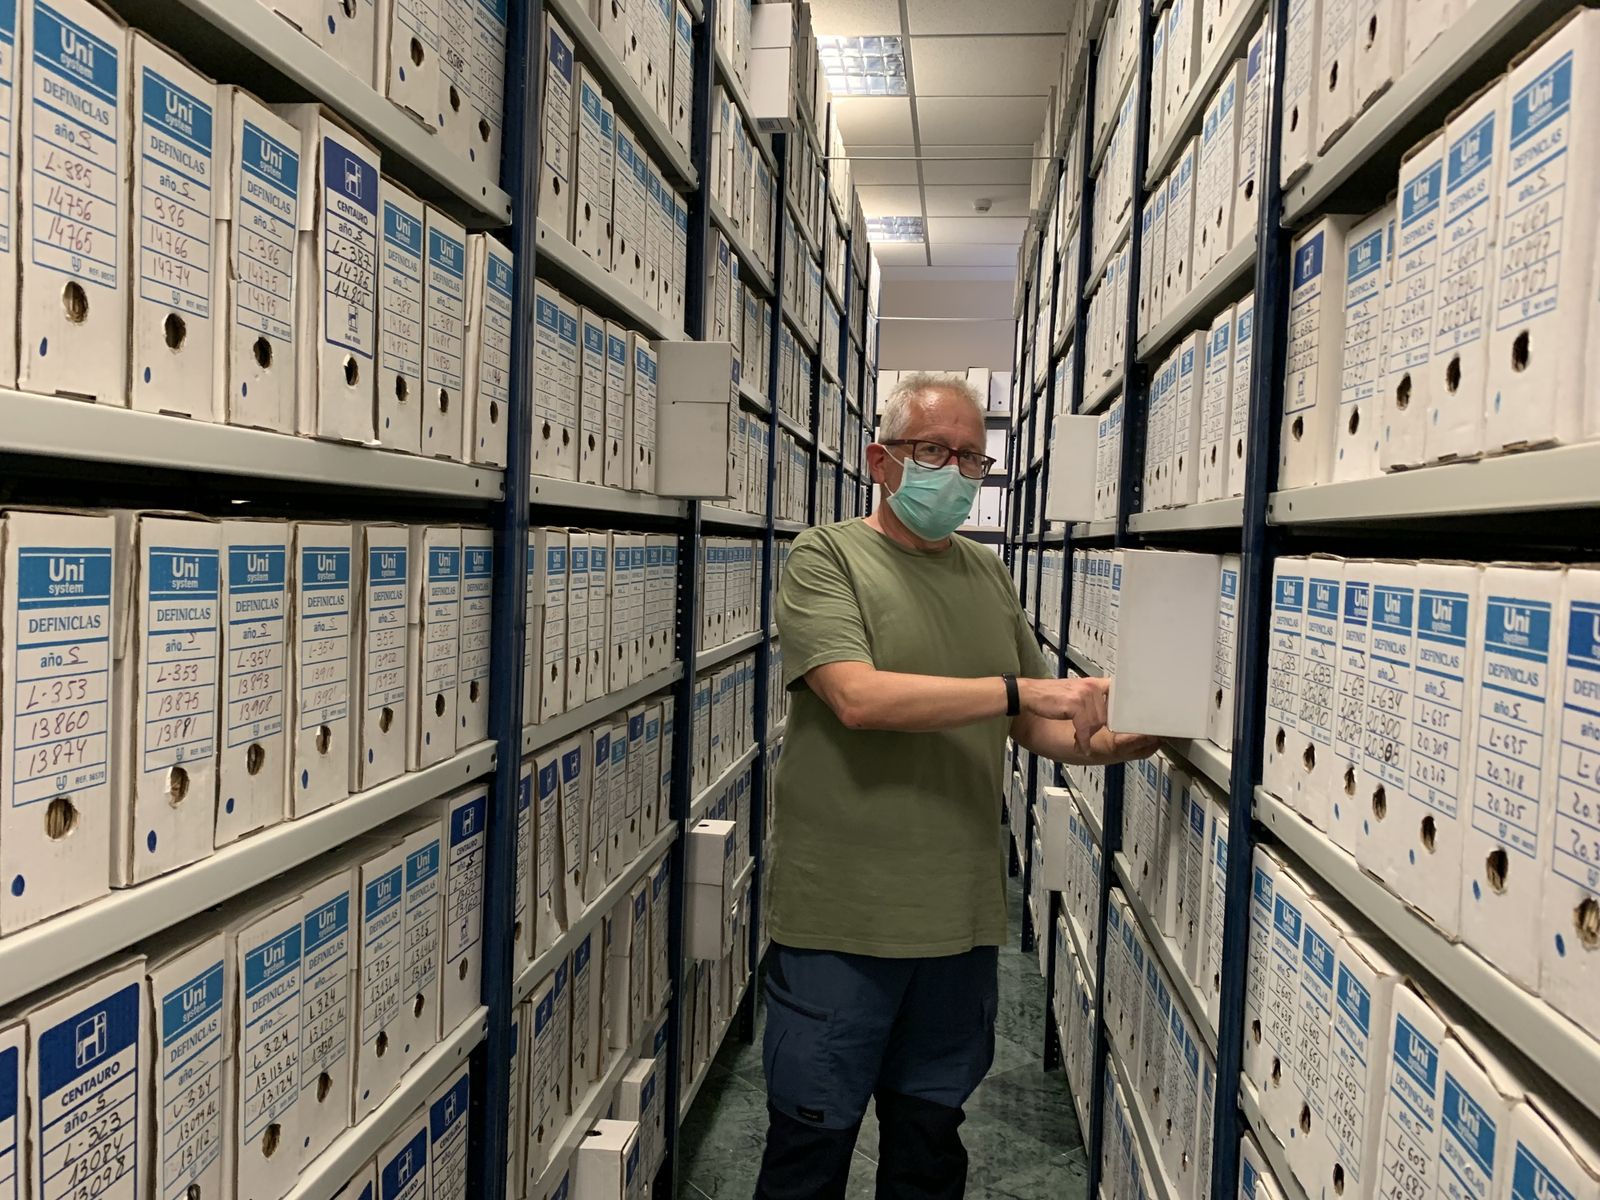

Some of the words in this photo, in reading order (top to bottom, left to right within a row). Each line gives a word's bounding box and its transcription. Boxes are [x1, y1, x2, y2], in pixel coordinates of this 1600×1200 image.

[61, 27, 94, 68] Uni
[43, 77, 110, 126] DEFINICLAS
[1528, 74, 1554, 112] Uni
[165, 89, 193, 122] Uni
[150, 135, 205, 174] DEFINICLAS
[261, 141, 283, 171] Uni
[1461, 128, 1481, 162] Uni
[248, 183, 291, 216] DEFINICLAS
[1414, 175, 1430, 201] Uni
[337, 199, 369, 227] CENTAURO
[338, 221, 353, 237] año
[395, 213, 410, 239] Uni
[388, 249, 417, 272] DEFINICLAS
[440, 239, 454, 260] Uni
[49, 558, 85, 582] Uni
[172, 557, 199, 578] Uni
[247, 554, 269, 572] Uni
[317, 555, 336, 572] Uni
[382, 554, 396, 569] Uni
[439, 553, 451, 567] Uni
[473, 552, 484, 566] Uni
[48, 583, 84, 594] system
[172, 578, 198, 589] system
[247, 573, 268, 583] system
[1284, 581, 1296, 597] Uni
[308, 595, 344, 608] DEFINICLAS
[374, 590, 402, 601] DEFINICLAS
[1316, 582, 1330, 602] Uni
[1384, 593, 1401, 614] Uni
[157, 608, 211, 622] DEFINICLAS
[236, 598, 279, 613] DEFINICLAS
[1432, 598, 1452, 621] Uni
[29, 615, 101, 633] DEFINICLAS
[1504, 607, 1530, 633] Uni
[243, 627, 256, 639] año
[166, 640, 182, 652] año
[1374, 638, 1406, 656] DEFINICLAS
[40, 653, 62, 668] año
[1420, 648, 1459, 668] DEFINICLAS
[1488, 663, 1539, 687] DEFINICLAS
[32, 710, 89, 740] 13860
[30, 738, 87, 776] 13874
[456, 839, 477, 856] CENTAURO
[416, 851, 430, 869] Uni
[377, 878, 391, 899] Uni
[319, 906, 336, 929] Uni
[370, 910, 397, 935] DEFINICLAS
[1283, 904, 1296, 929] Uni
[263, 940, 286, 968] Uni
[309, 939, 344, 970] DEFINICLAS
[1312, 935, 1325, 962] Uni
[183, 980, 207, 1010] Uni
[252, 976, 295, 1013] DEFINICLAS
[1347, 976, 1361, 1007] Uni
[183, 1001, 206, 1023] system
[170, 1020, 217, 1063] DEFINICLAS
[1408, 1032, 1429, 1069] Uni
[61, 1061, 120, 1107] CENTAURO
[64, 1111, 88, 1134] año
[1458, 1094, 1480, 1138] Uni
